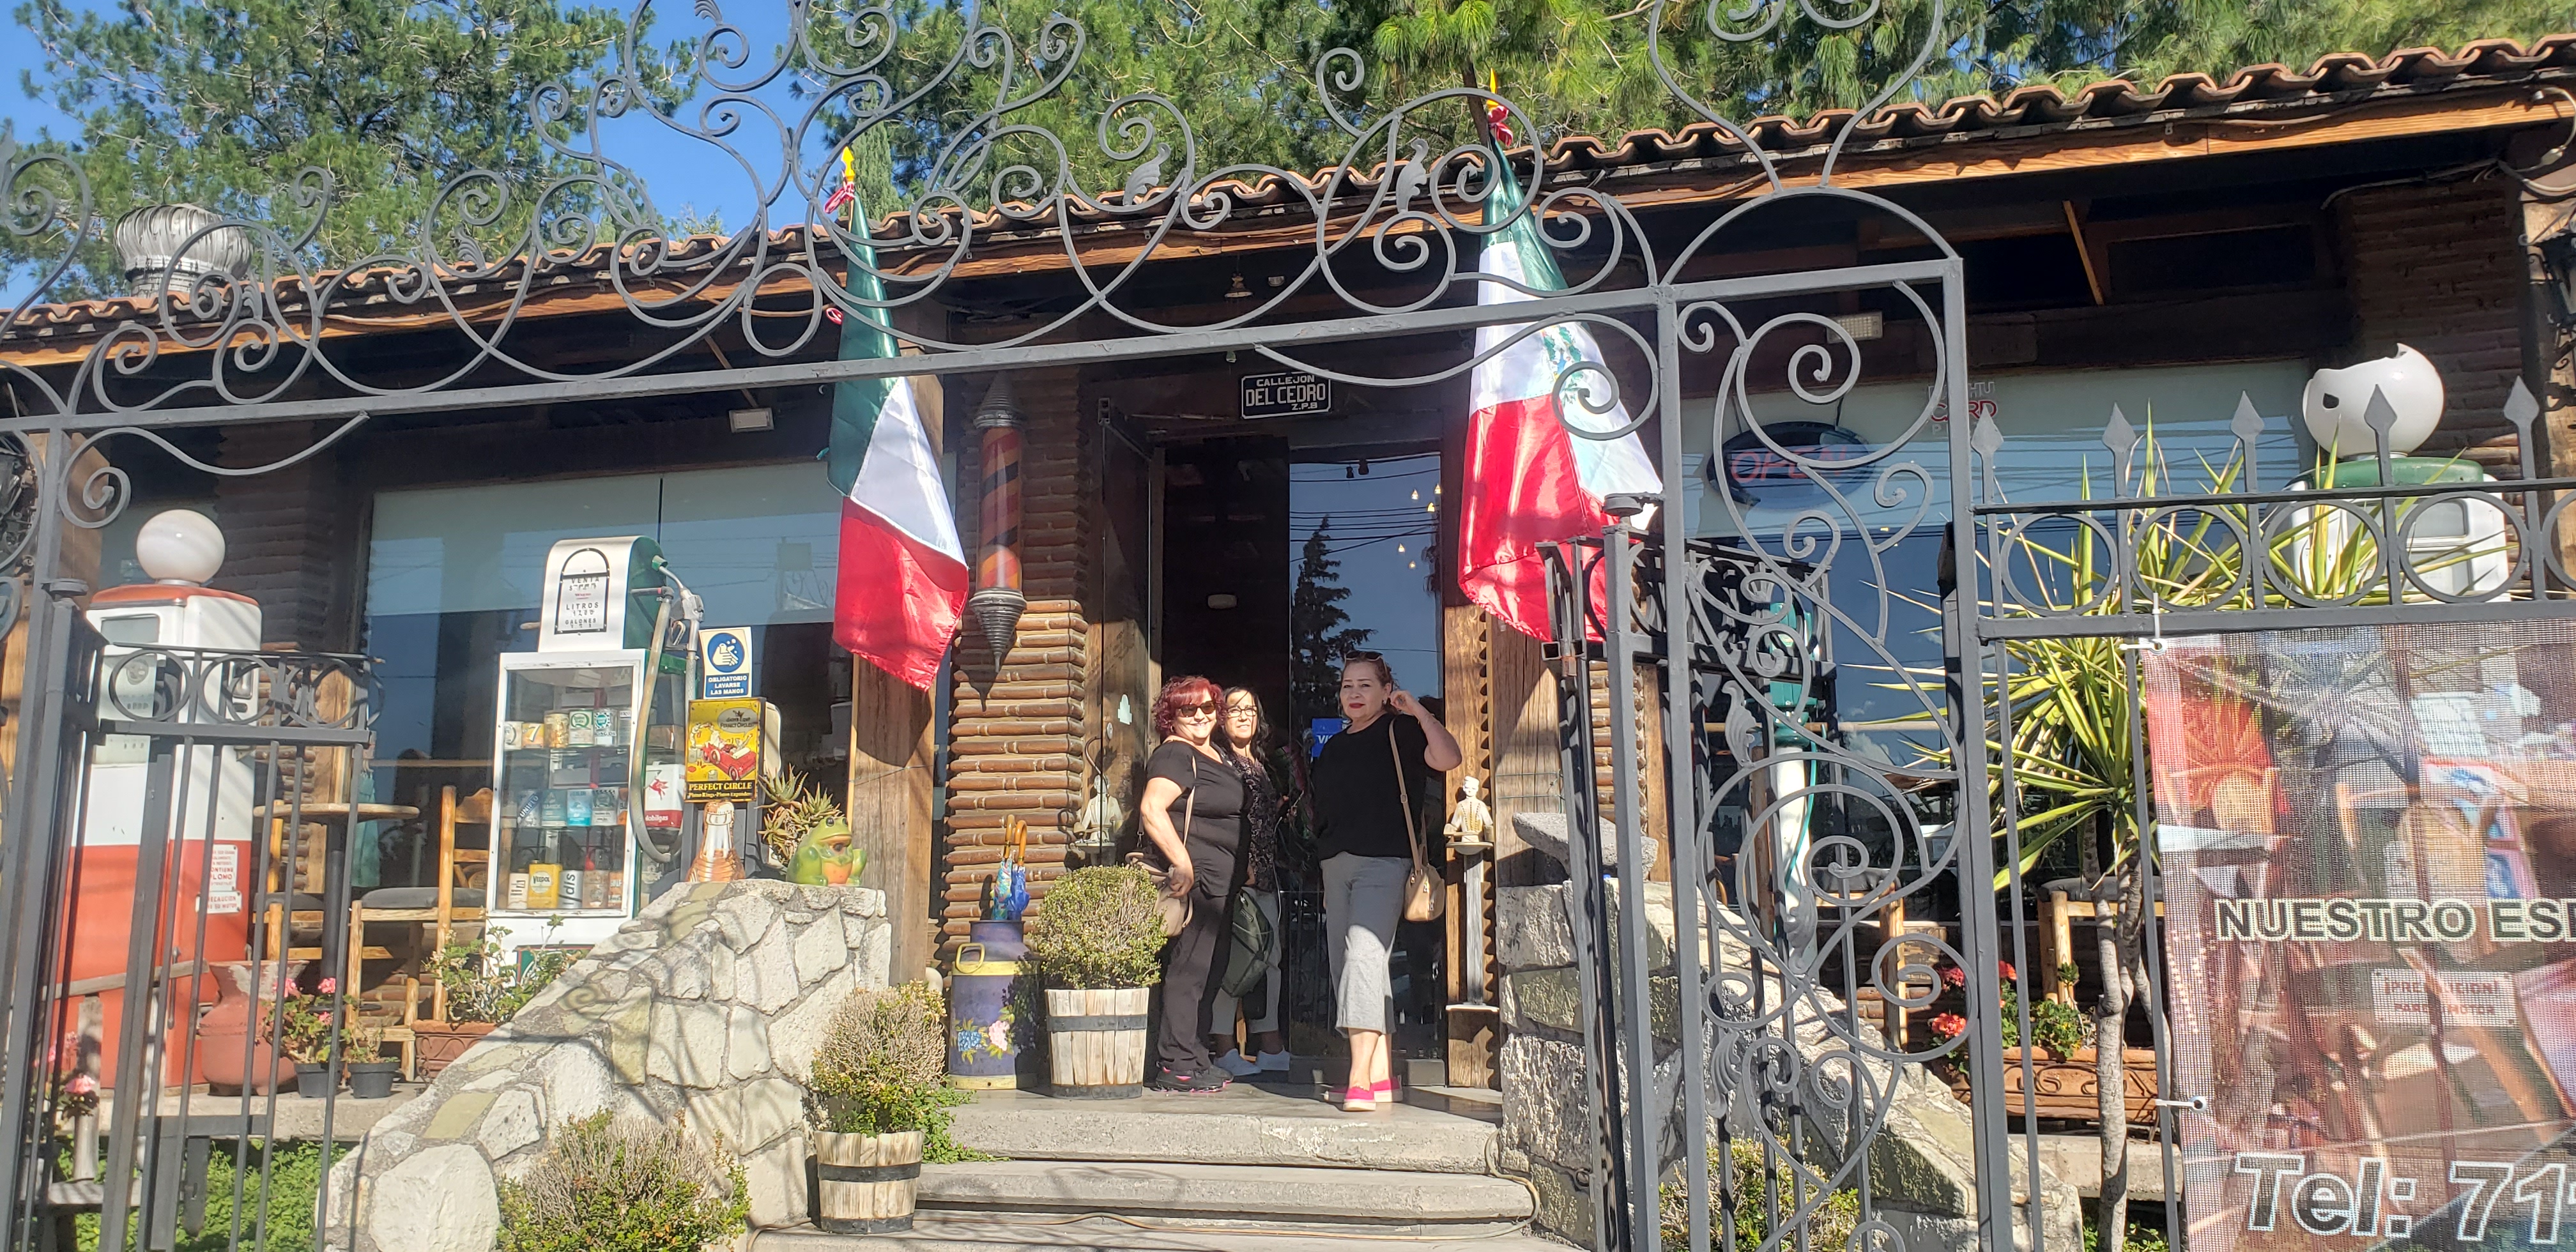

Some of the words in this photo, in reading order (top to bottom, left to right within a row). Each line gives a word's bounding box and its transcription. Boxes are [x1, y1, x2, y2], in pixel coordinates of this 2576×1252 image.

[1256, 375, 1315, 387] CALLEJON
[1246, 388, 1275, 407] DEL
[1277, 383, 1326, 404] CEDRO
[566, 602, 599, 610] LITROS
[689, 782, 723, 791] PERFECT
[723, 782, 753, 790] CIRCLE
[533, 875, 551, 884] VEEDOL
[2216, 897, 2476, 942] NUESTRO
[2235, 1151, 2418, 1238] Tel:
